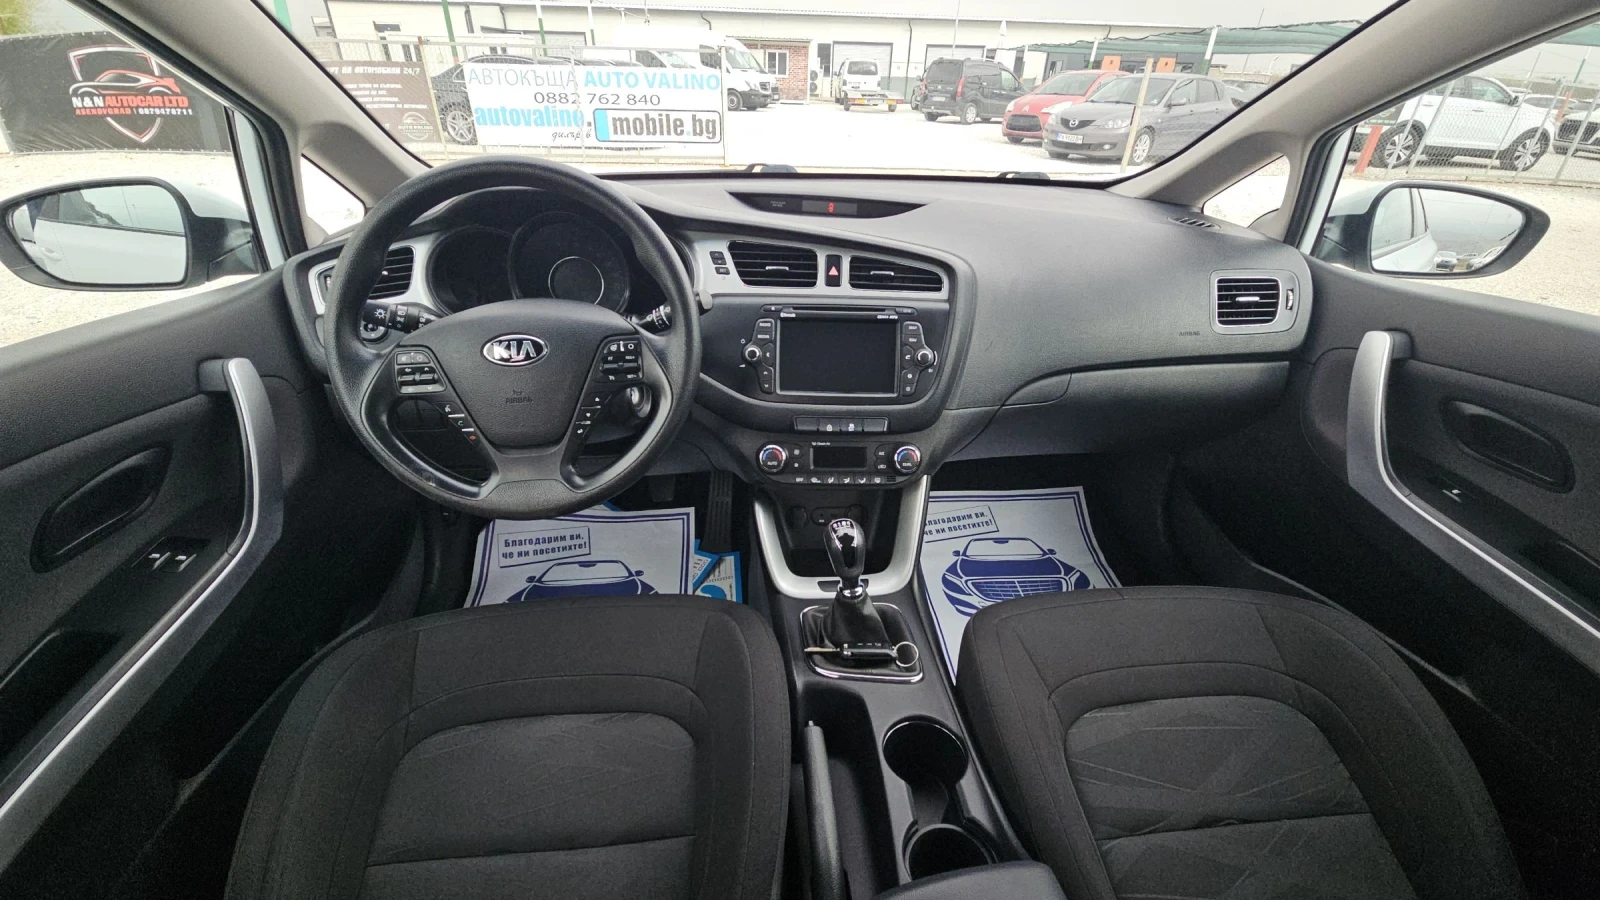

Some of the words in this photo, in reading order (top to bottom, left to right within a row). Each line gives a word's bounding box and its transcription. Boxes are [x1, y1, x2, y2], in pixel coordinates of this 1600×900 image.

[468, 68, 576, 89] АВТОКЪЩА
[584, 70, 639, 88] AUTO
[643, 71, 720, 90] VALINO
[72, 96, 104, 108] N&N
[534, 92, 580, 104] 0882
[586, 92, 620, 105] 762
[626, 94, 661, 106] 840
[612, 113, 716, 140] mobile.bg
[493, 340, 537, 362] KIA
[936, 526, 946, 534] ни
[948, 519, 994, 532] посетихте!
[502, 551, 515, 560] че
[517, 550, 530, 558] ни
[532, 541, 587, 558] посетихте!
[504, 534, 567, 548] Благодарим
